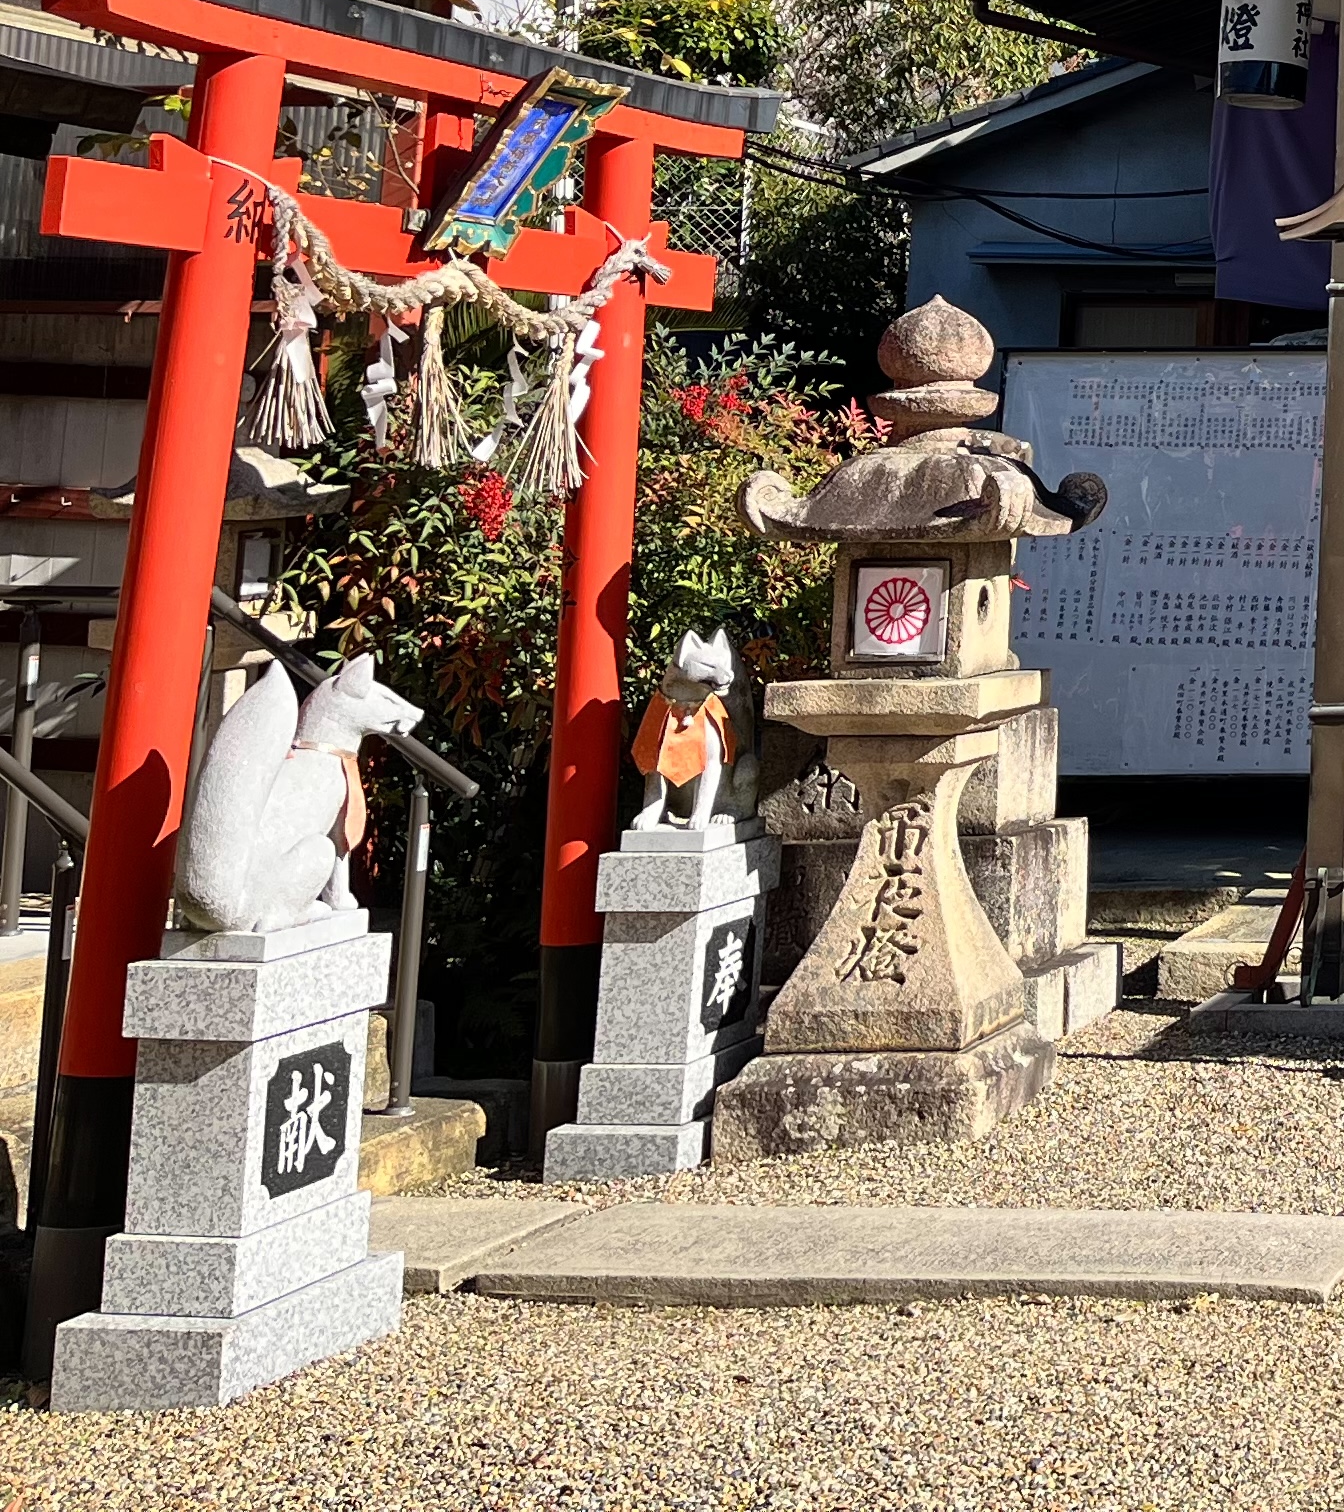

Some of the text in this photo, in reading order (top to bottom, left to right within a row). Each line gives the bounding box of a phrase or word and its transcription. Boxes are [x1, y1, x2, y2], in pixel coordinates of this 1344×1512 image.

[834, 777, 931, 986] 常夜燈
[707, 932, 746, 1015] 奉
[277, 1063, 337, 1175] 献
